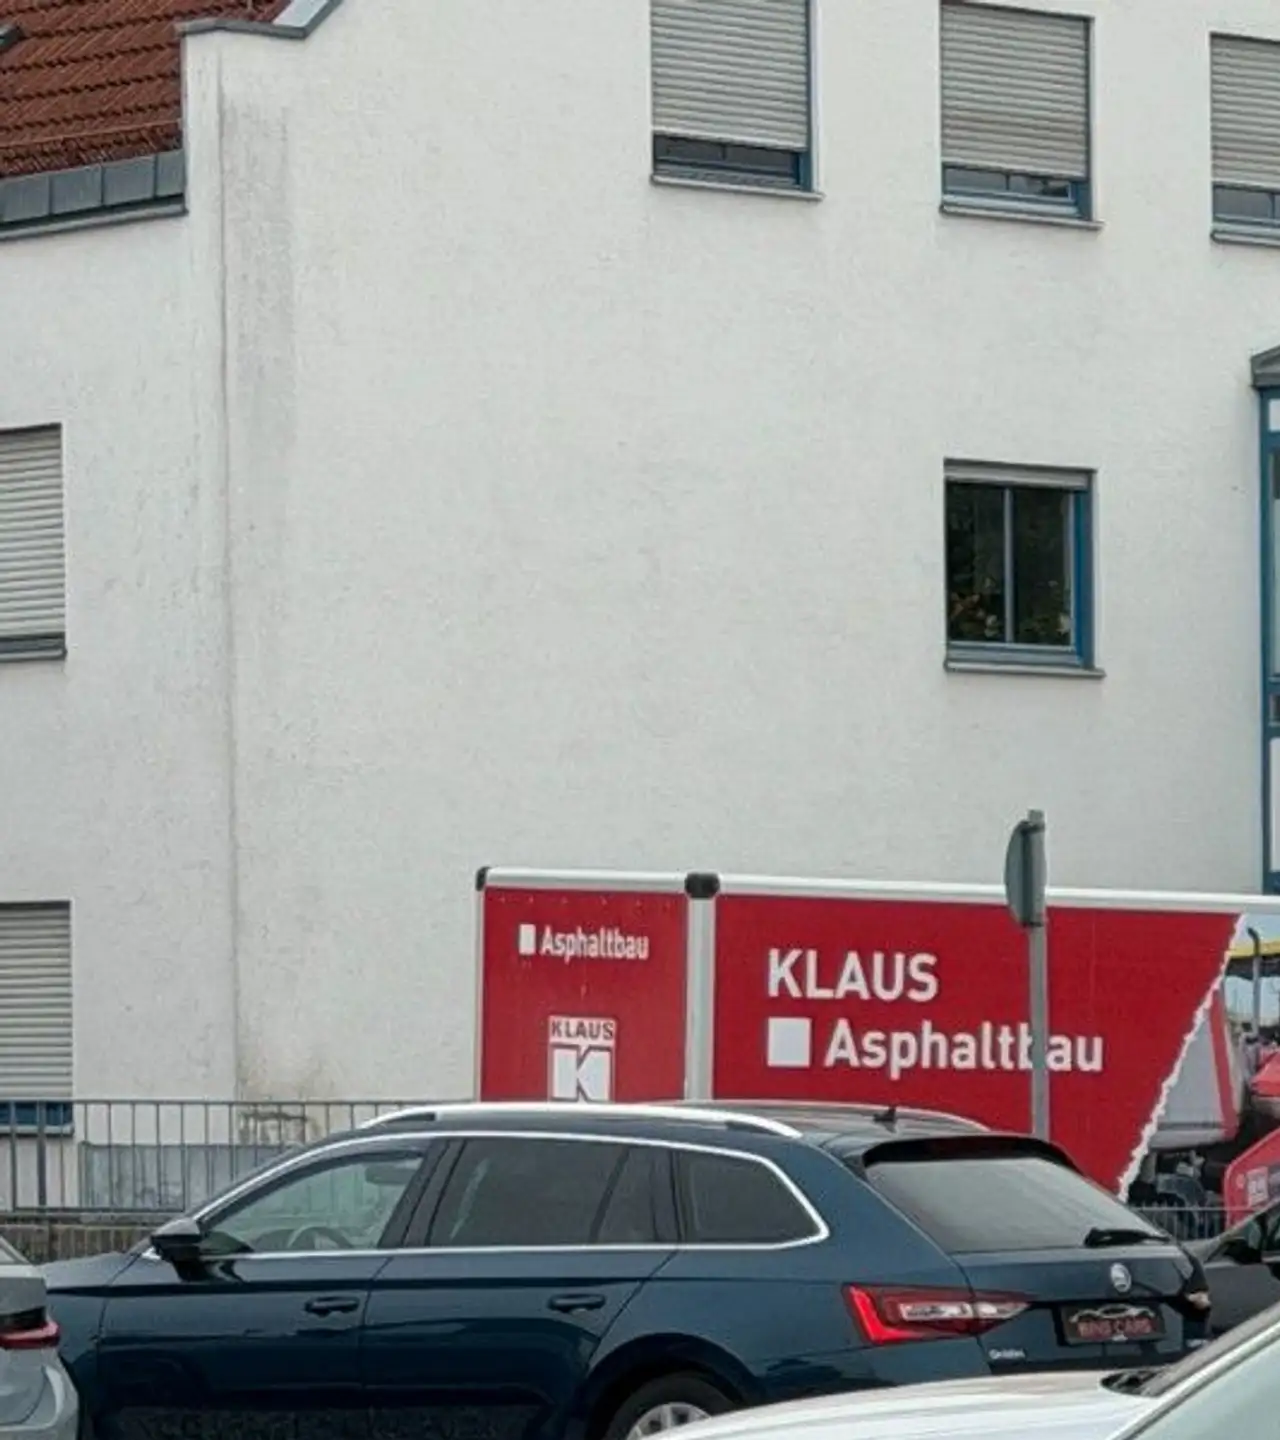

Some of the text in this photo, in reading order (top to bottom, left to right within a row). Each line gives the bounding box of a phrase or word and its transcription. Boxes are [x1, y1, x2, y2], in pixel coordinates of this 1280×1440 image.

[540, 926, 649, 964] Asphaltbau
[768, 948, 938, 1002] KLAUS
[551, 1020, 614, 1040] KLAUS
